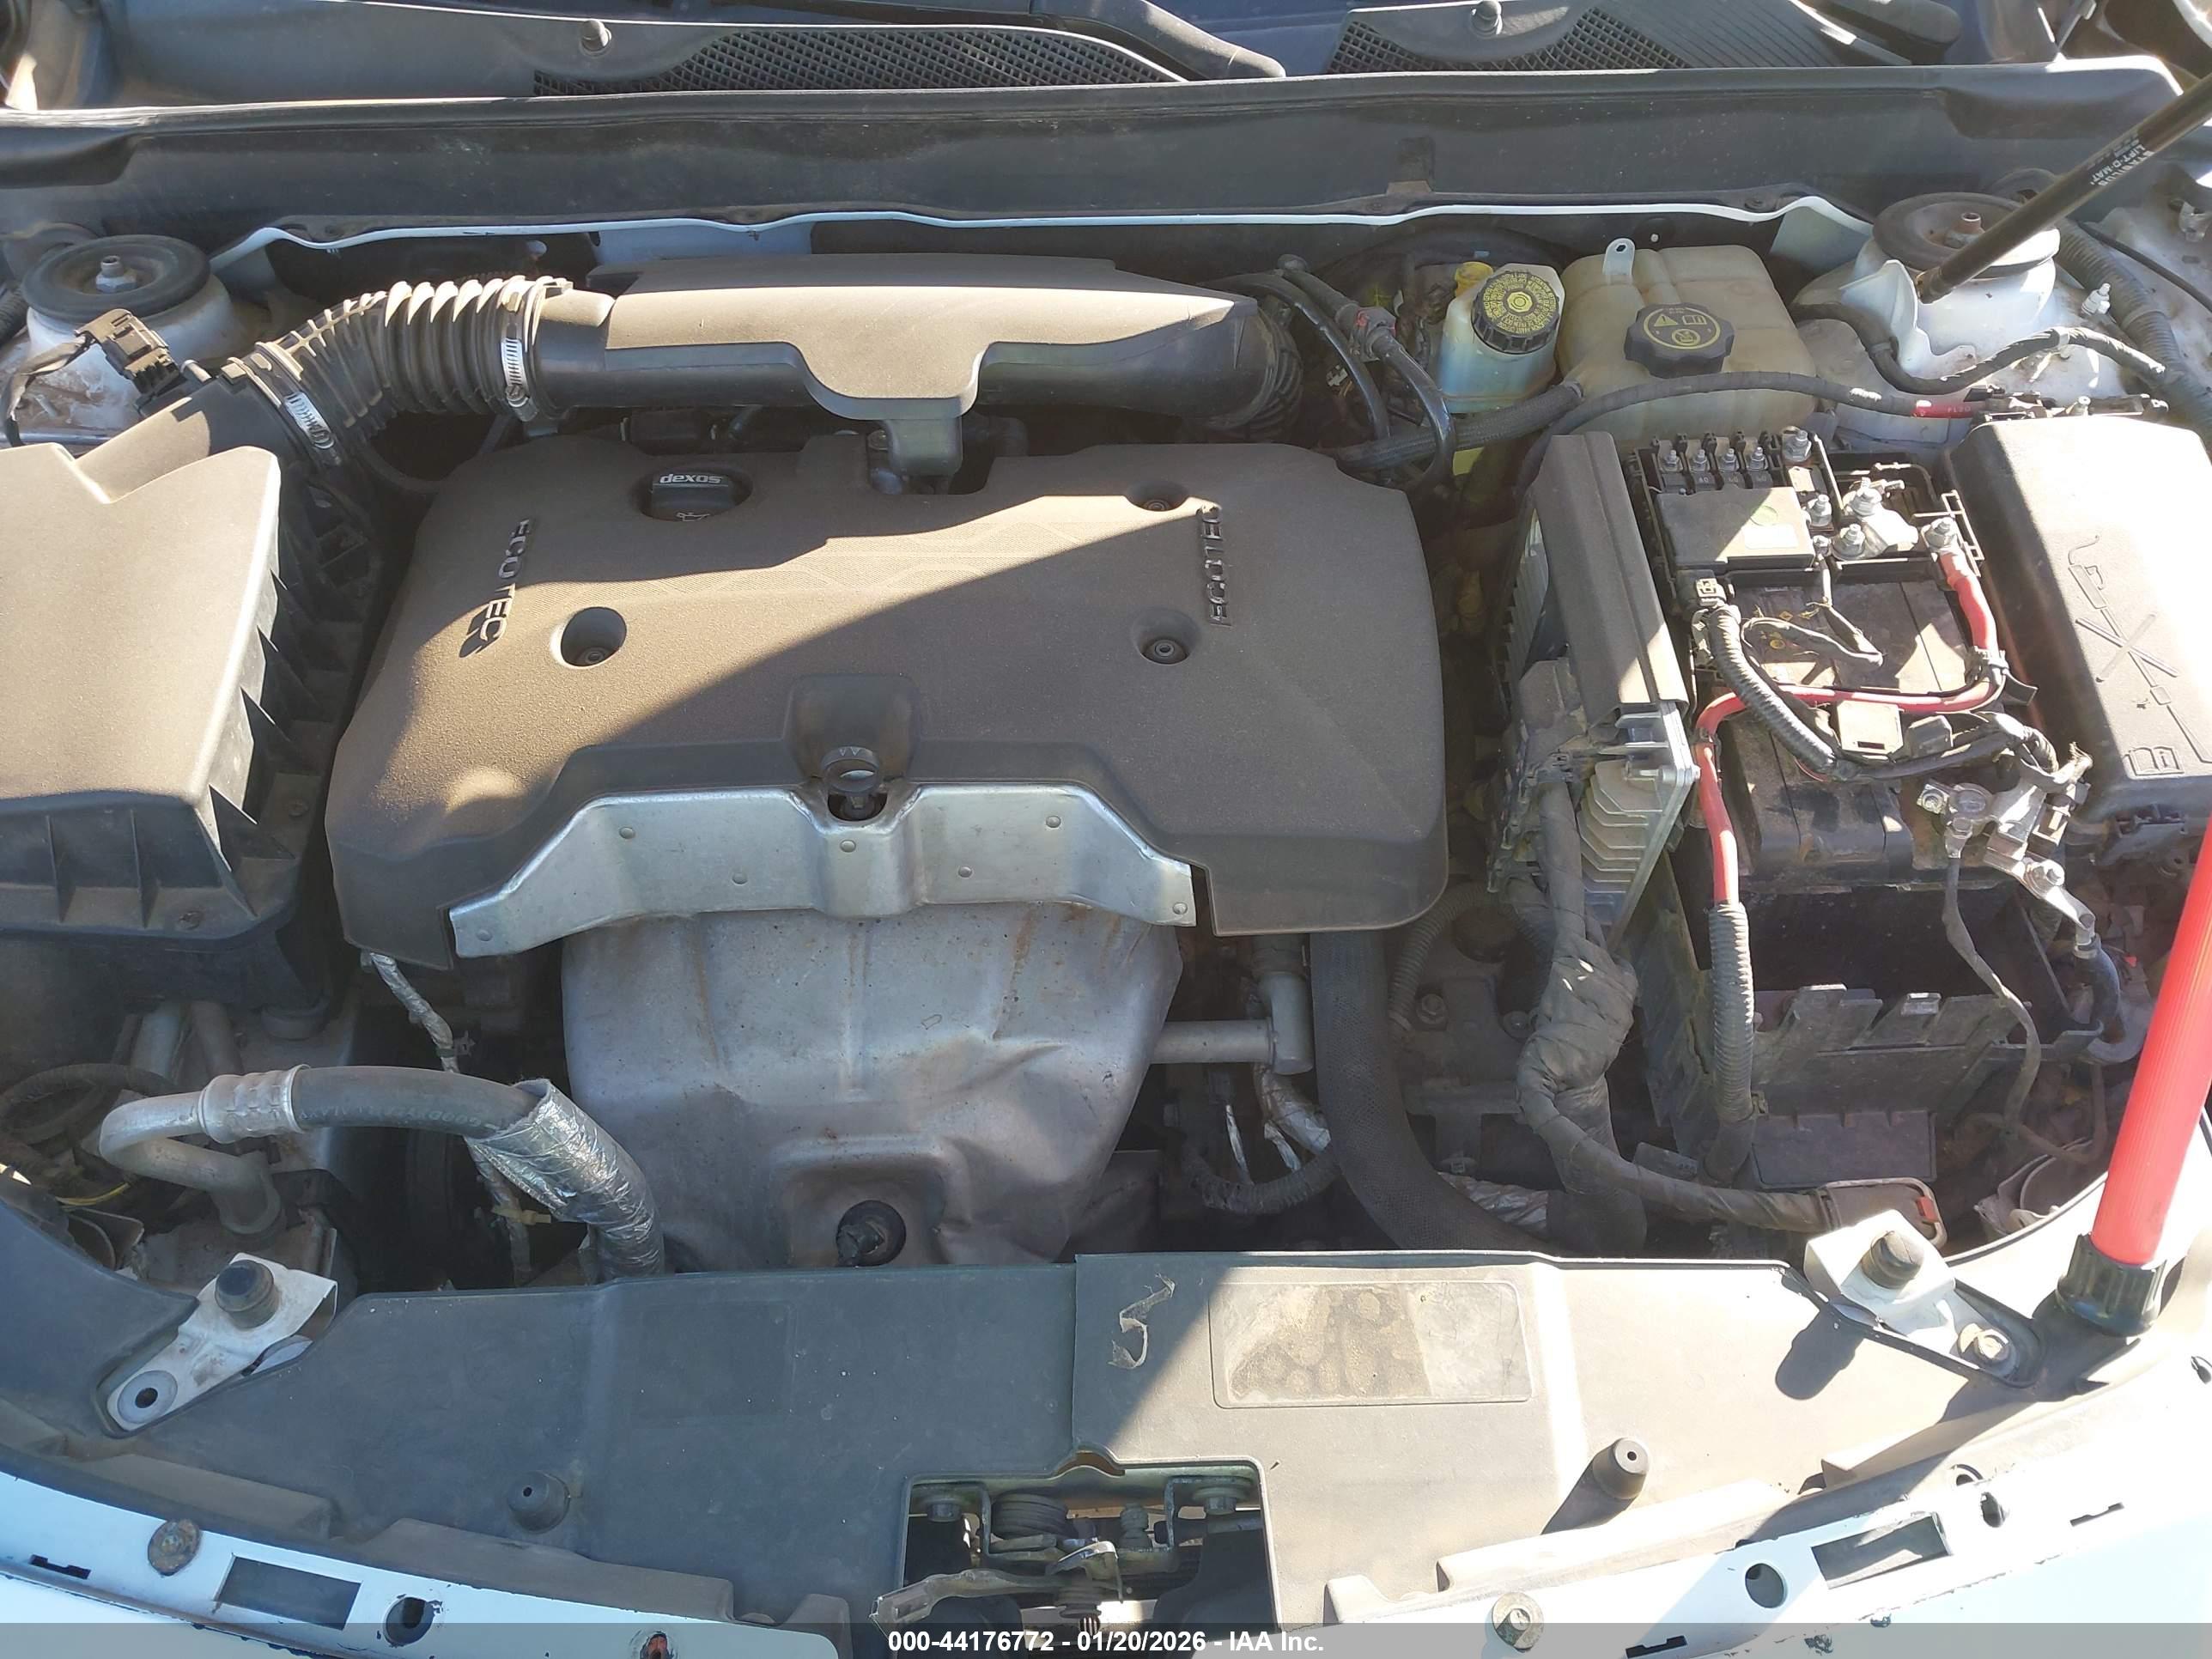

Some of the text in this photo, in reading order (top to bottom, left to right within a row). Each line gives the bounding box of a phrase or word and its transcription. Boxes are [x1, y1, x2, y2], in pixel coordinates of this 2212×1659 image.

[659, 473, 723, 483] dexos
[477, 519, 531, 642] ECOTEC
[1201, 505, 1232, 628] ECOTEC
